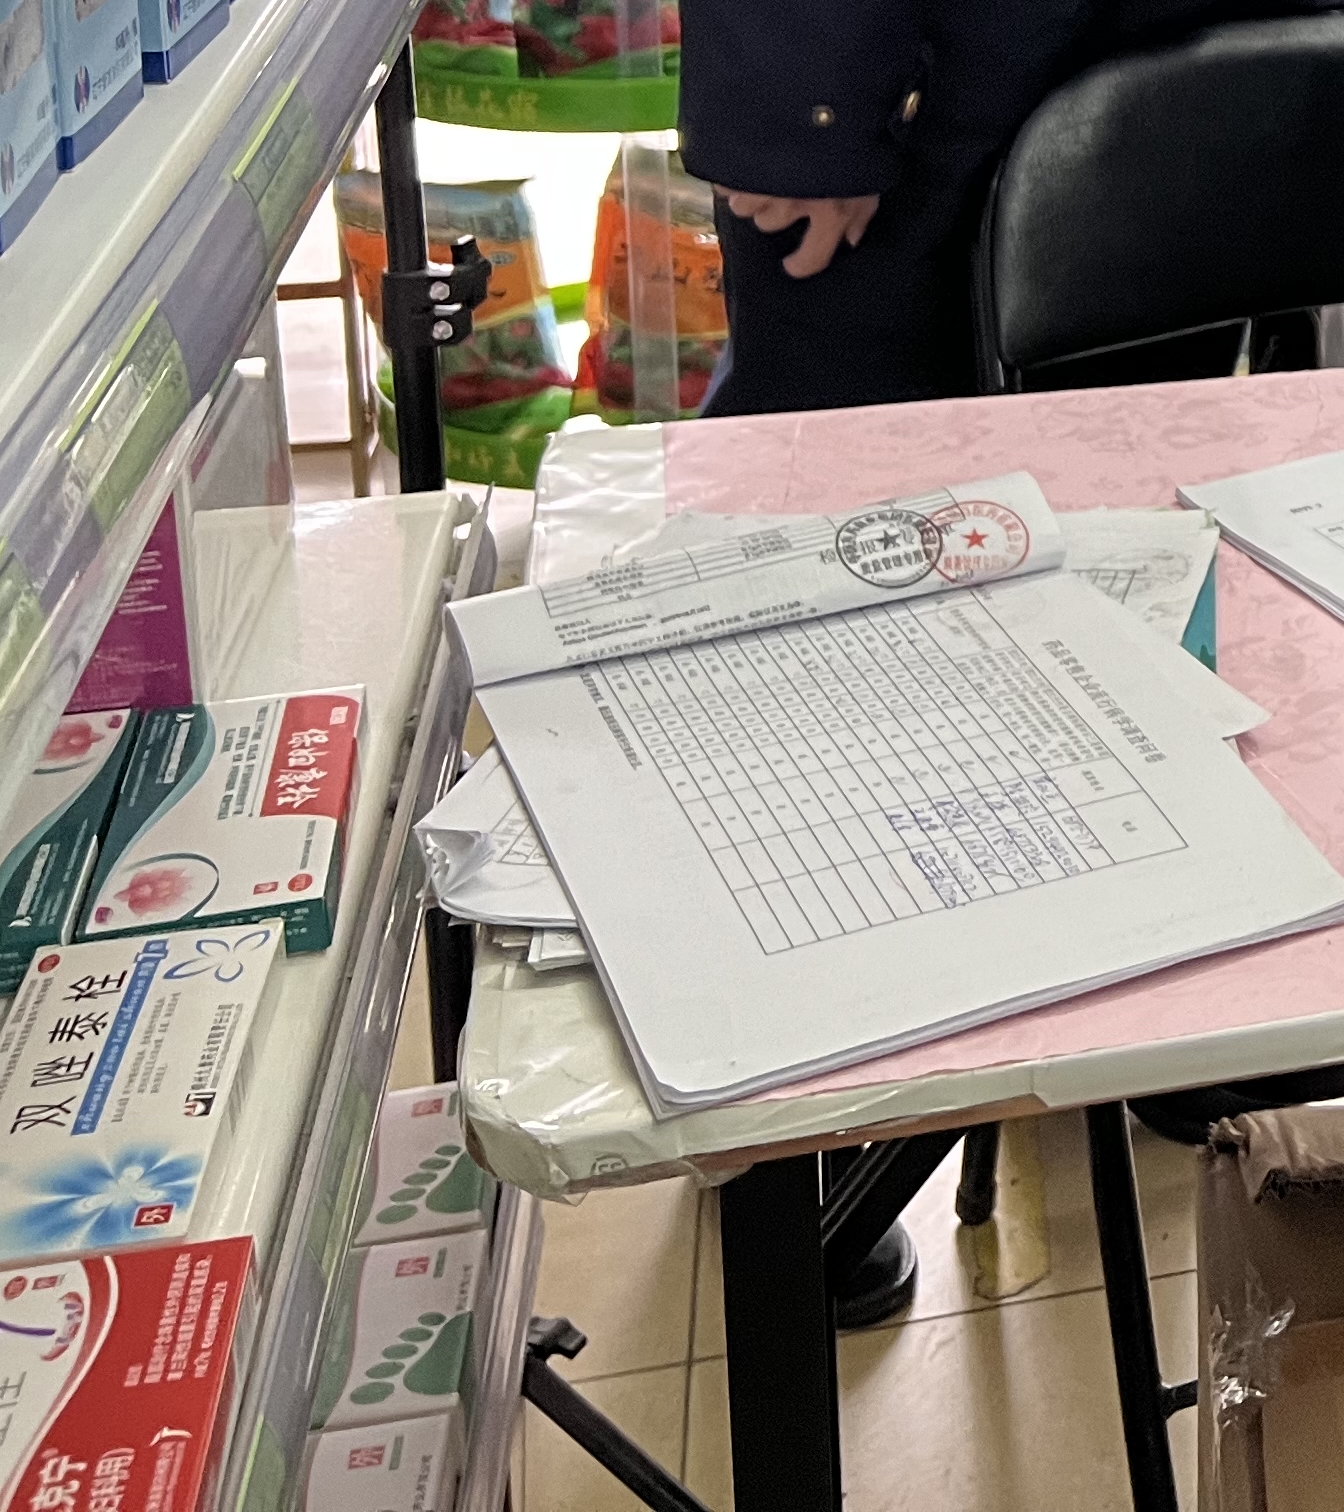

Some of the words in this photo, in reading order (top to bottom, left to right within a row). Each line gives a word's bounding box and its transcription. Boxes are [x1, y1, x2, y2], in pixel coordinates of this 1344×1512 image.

[275, 728, 330, 809] 保妇康栓
[10, 969, 128, 1134] 双唑泰栓
